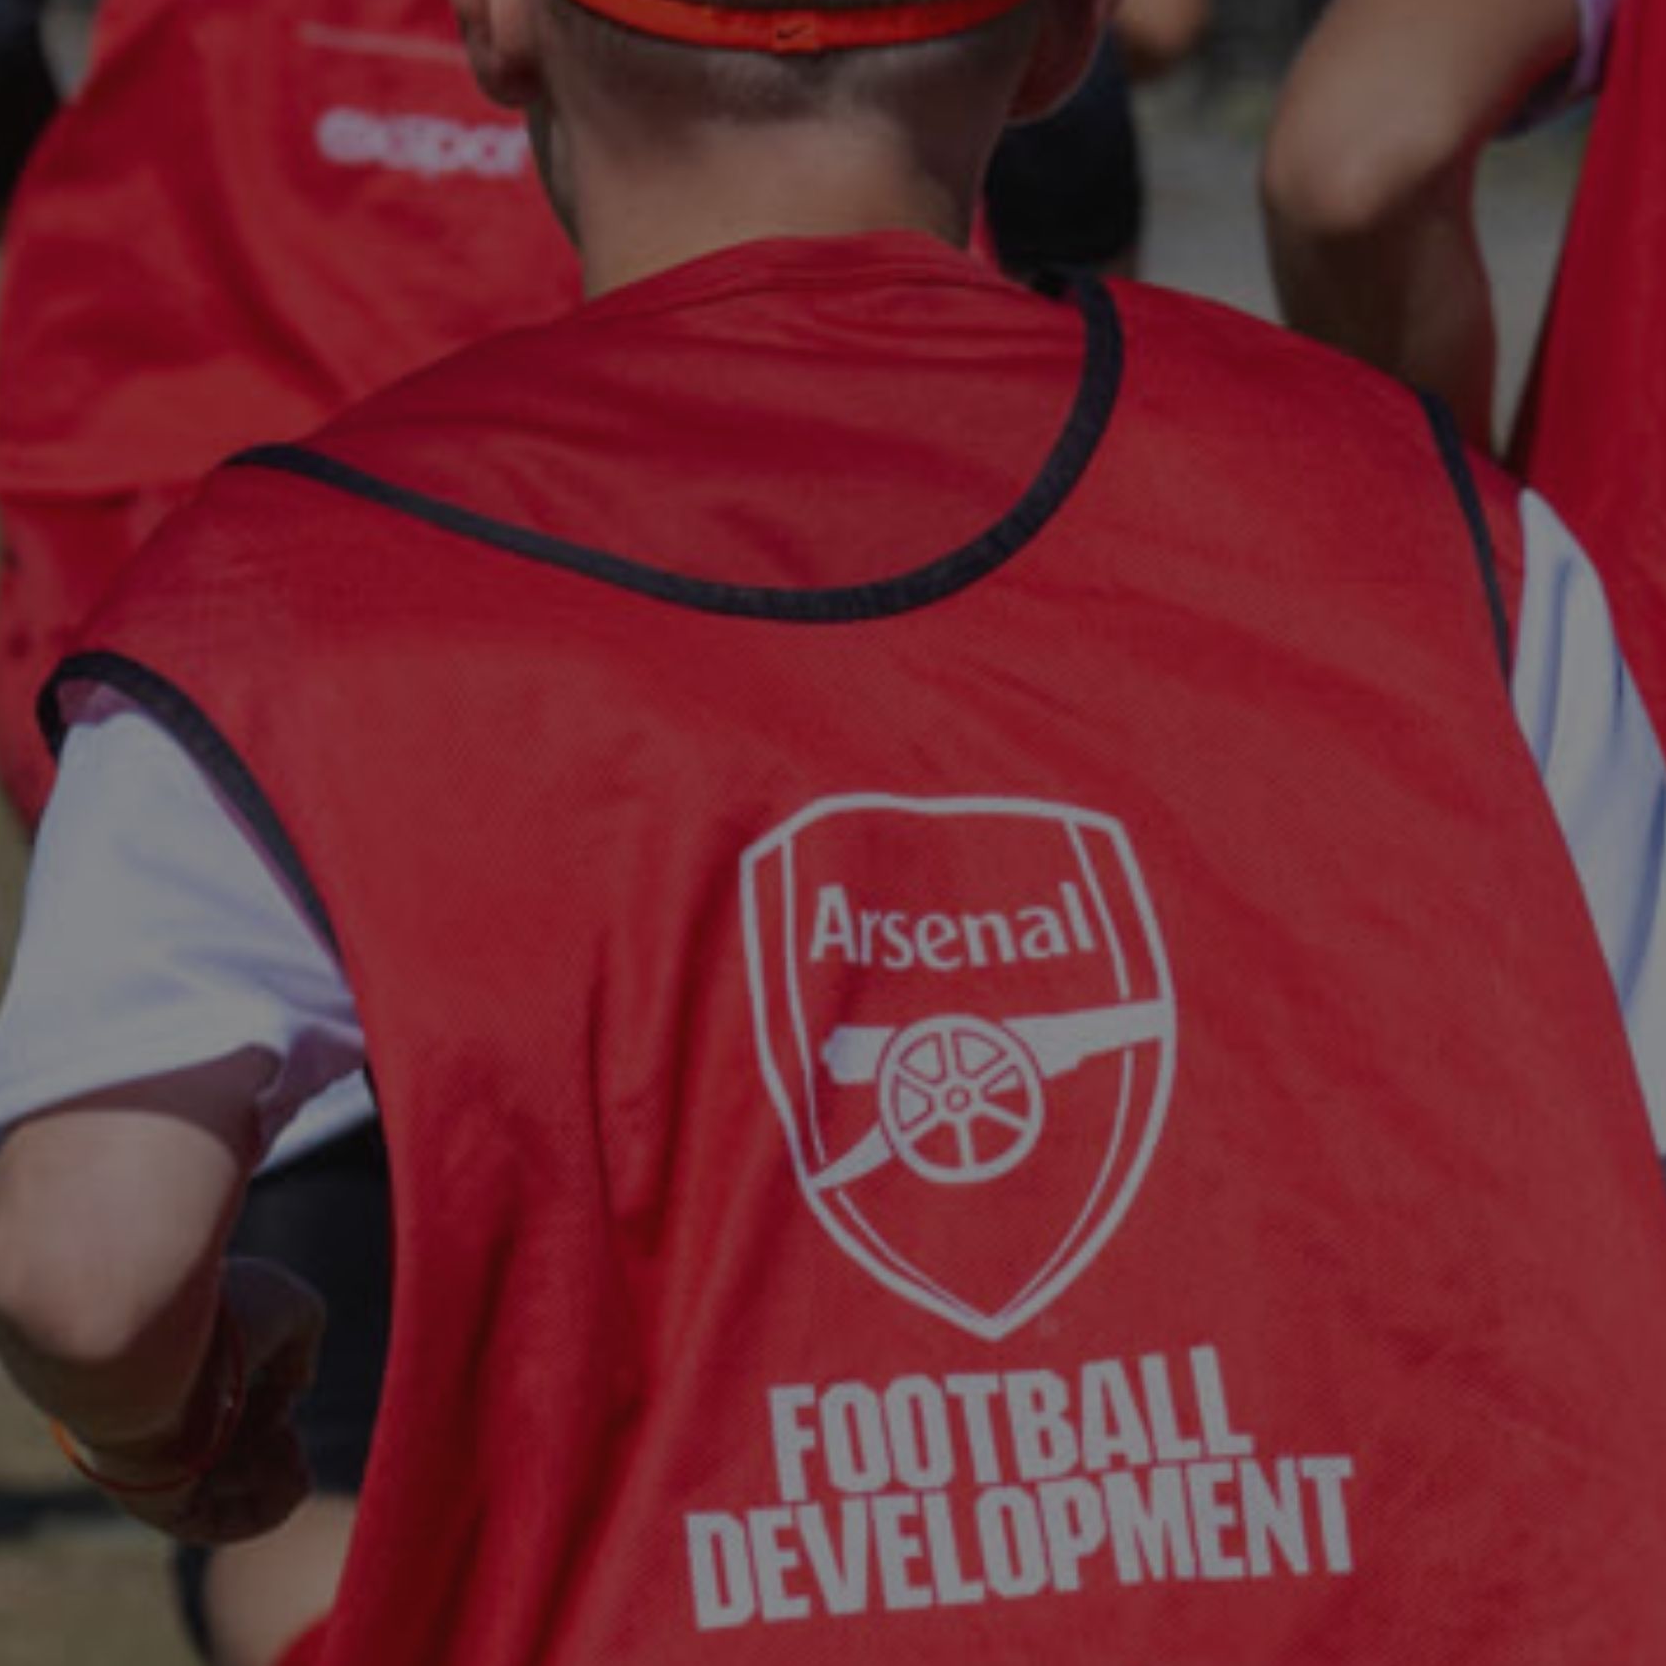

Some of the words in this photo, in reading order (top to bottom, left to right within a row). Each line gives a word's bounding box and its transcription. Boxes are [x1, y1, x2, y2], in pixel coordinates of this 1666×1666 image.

[808, 880, 1096, 971] Arsenal
[770, 1345, 1252, 1502] FOOTBALL
[687, 1457, 1352, 1630] DEVELOPMENT
